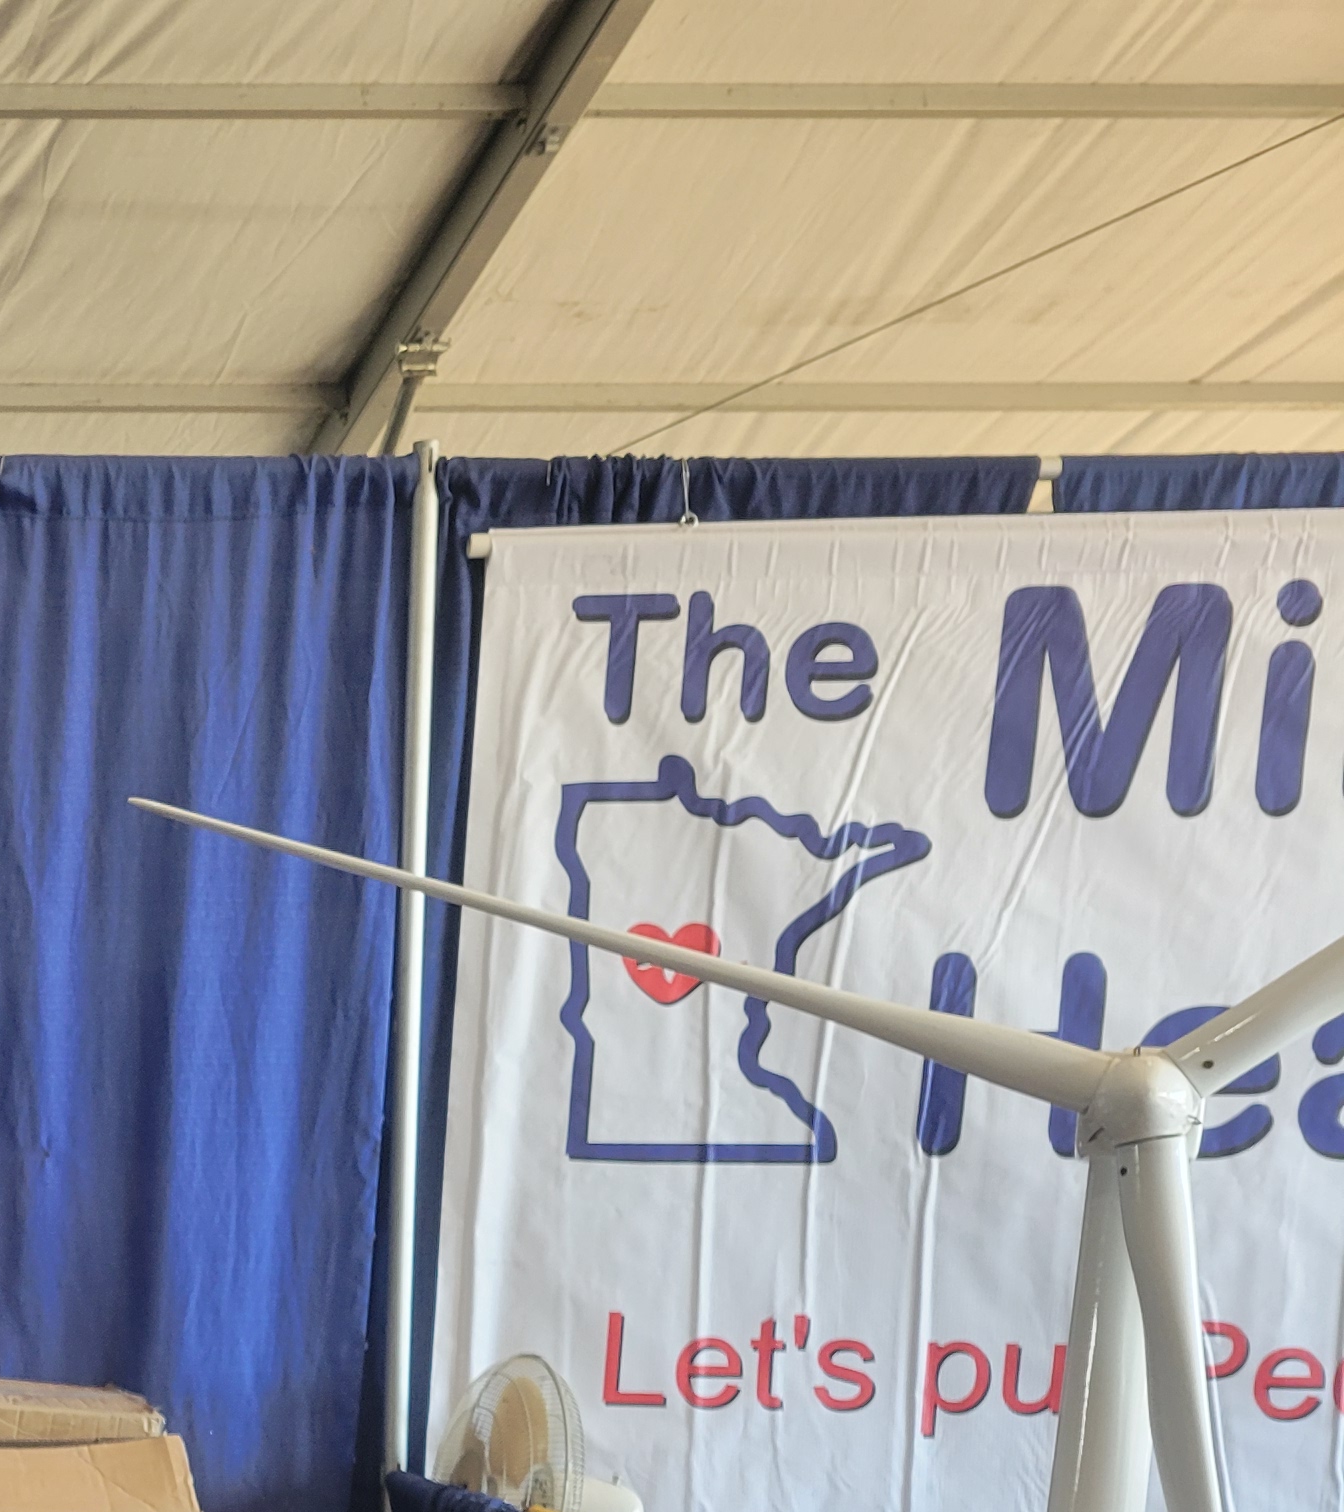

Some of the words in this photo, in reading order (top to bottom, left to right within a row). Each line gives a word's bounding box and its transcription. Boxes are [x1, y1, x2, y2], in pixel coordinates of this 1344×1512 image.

[572, 590, 880, 725] The
[983, 579, 1344, 819] Mi
[602, 1311, 876, 1411] Let's
[920, 1340, 1069, 1437] pu
[1201, 1319, 1344, 1422] Pe
